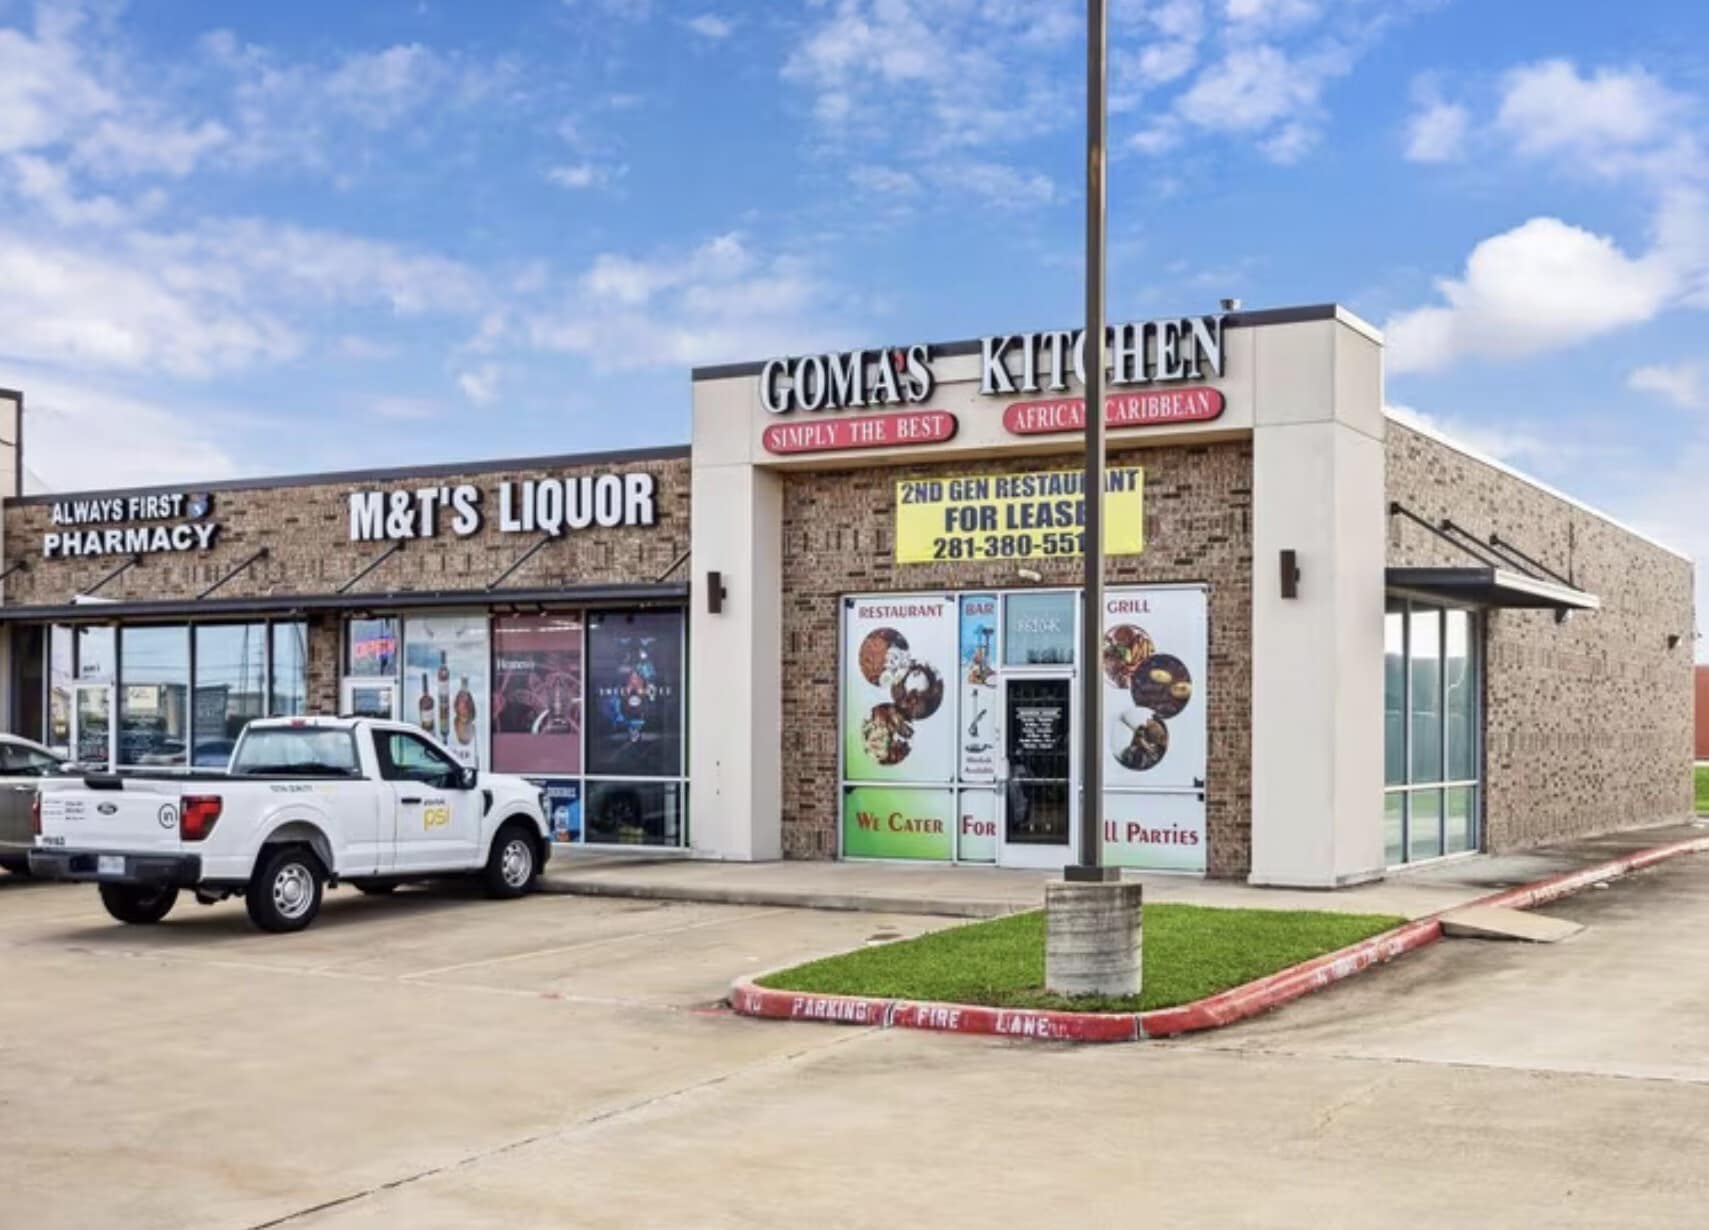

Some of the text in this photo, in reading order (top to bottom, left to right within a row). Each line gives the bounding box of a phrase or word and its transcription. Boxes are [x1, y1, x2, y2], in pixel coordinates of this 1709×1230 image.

[761, 344, 932, 413] GOMA'S
[1105, 390, 1212, 422] CARIBBEAN
[771, 415, 944, 449] SIMPLY THE BEST
[901, 469, 1140, 504] 2ND GEN RESTAUNT
[51, 493, 183, 525] ALWAYS FIRST
[350, 473, 654, 541] M&T'S LIQUOR
[945, 505, 998, 533] FOR
[43, 523, 217, 557] PHARMACY
[933, 532, 1087, 560] 281-380-551
[858, 604, 944, 620] RESTAURANT
[965, 602, 995, 616] BAR
[1107, 600, 1150, 614] GRILL
[792, 997, 867, 1022] PARKING
[917, 1006, 962, 1030] FIRE
[996, 1011, 1050, 1037] LANE
